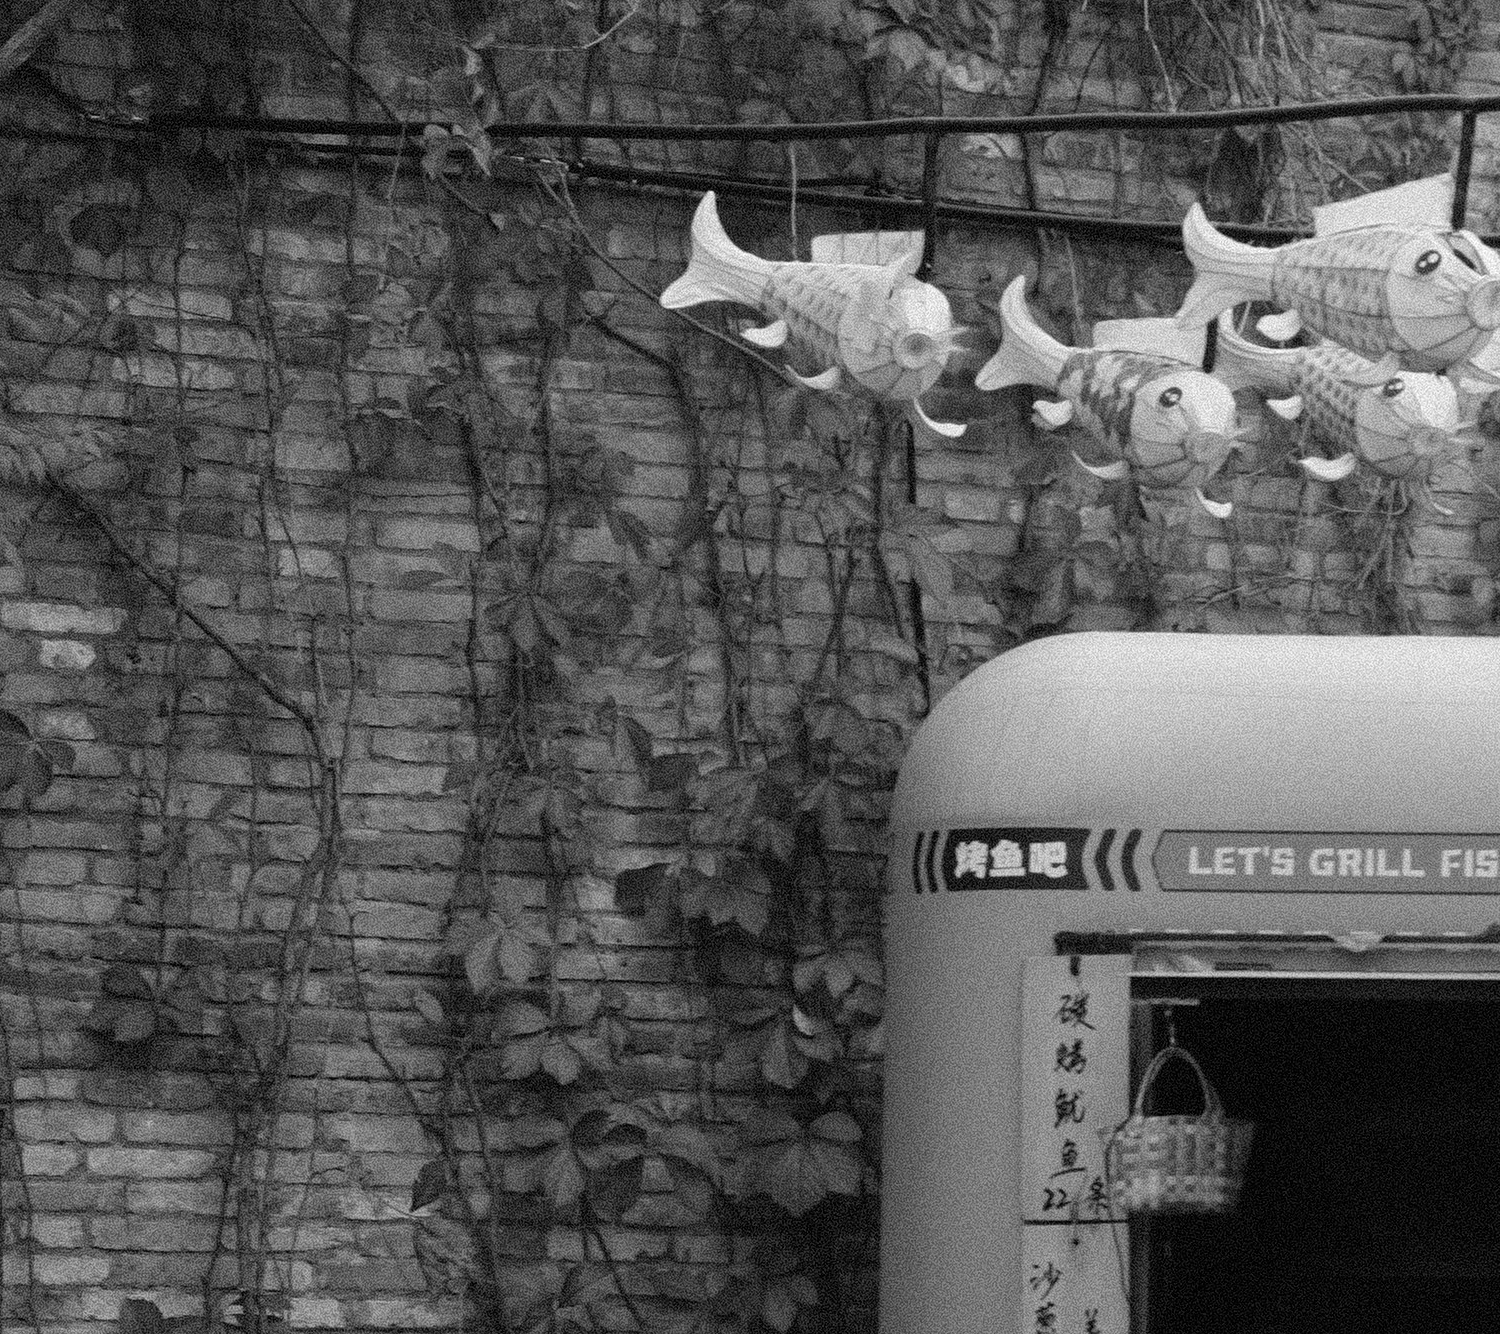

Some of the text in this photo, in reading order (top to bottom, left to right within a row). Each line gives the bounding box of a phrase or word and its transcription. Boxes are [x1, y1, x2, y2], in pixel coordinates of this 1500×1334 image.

[953, 839, 1068, 879] 烤鱼吧
[1188, 846, 1296, 877] LET'S
[1308, 847, 1426, 878] GRILL
